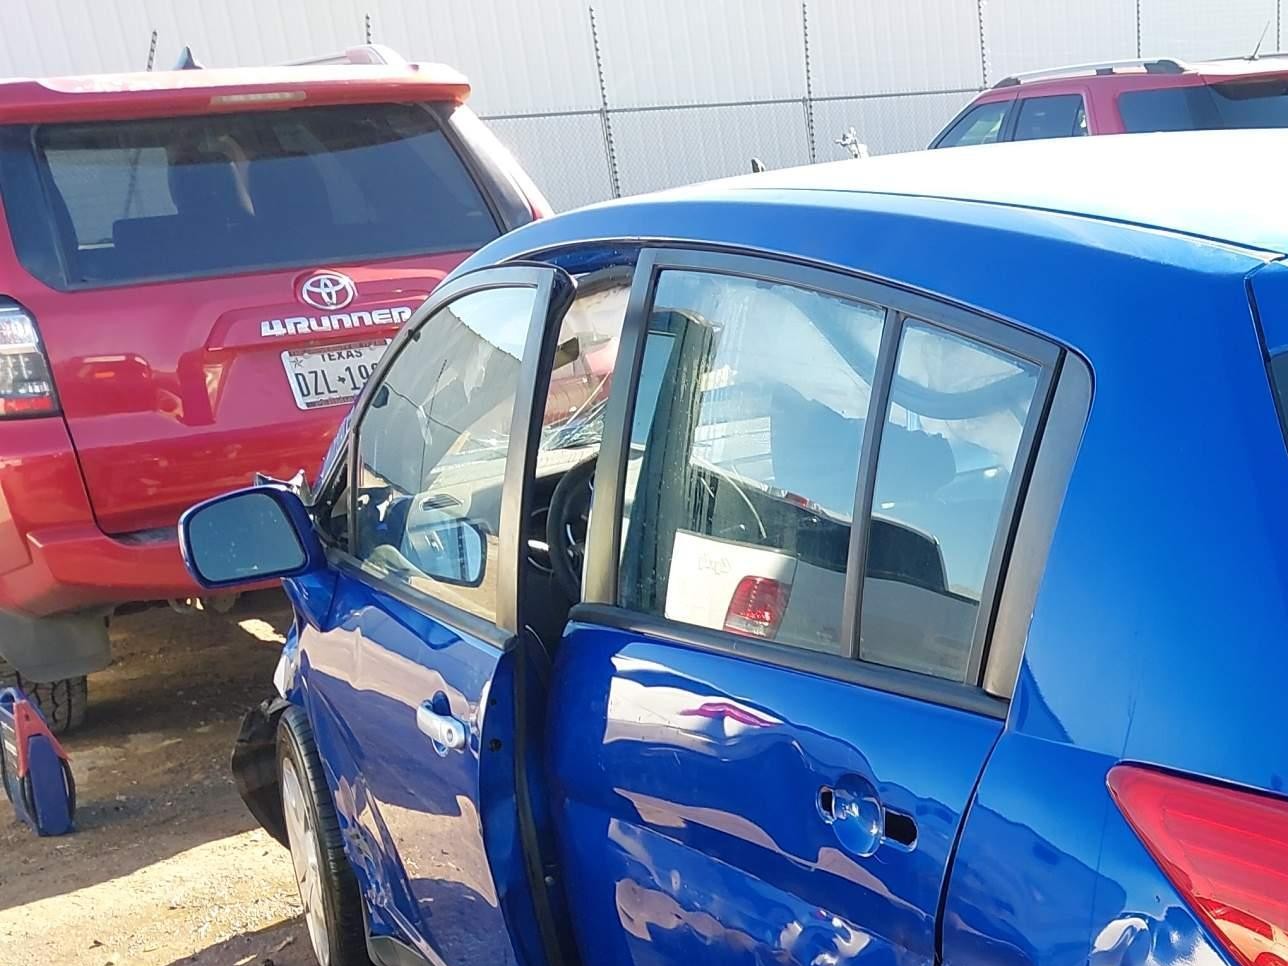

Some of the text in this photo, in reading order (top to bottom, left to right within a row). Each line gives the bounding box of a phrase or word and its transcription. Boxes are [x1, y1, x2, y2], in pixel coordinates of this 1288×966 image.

[260, 306, 412, 337] 4RUNNER
[320, 349, 363, 363] TEXAS
[294, 369, 338, 397] DZL
